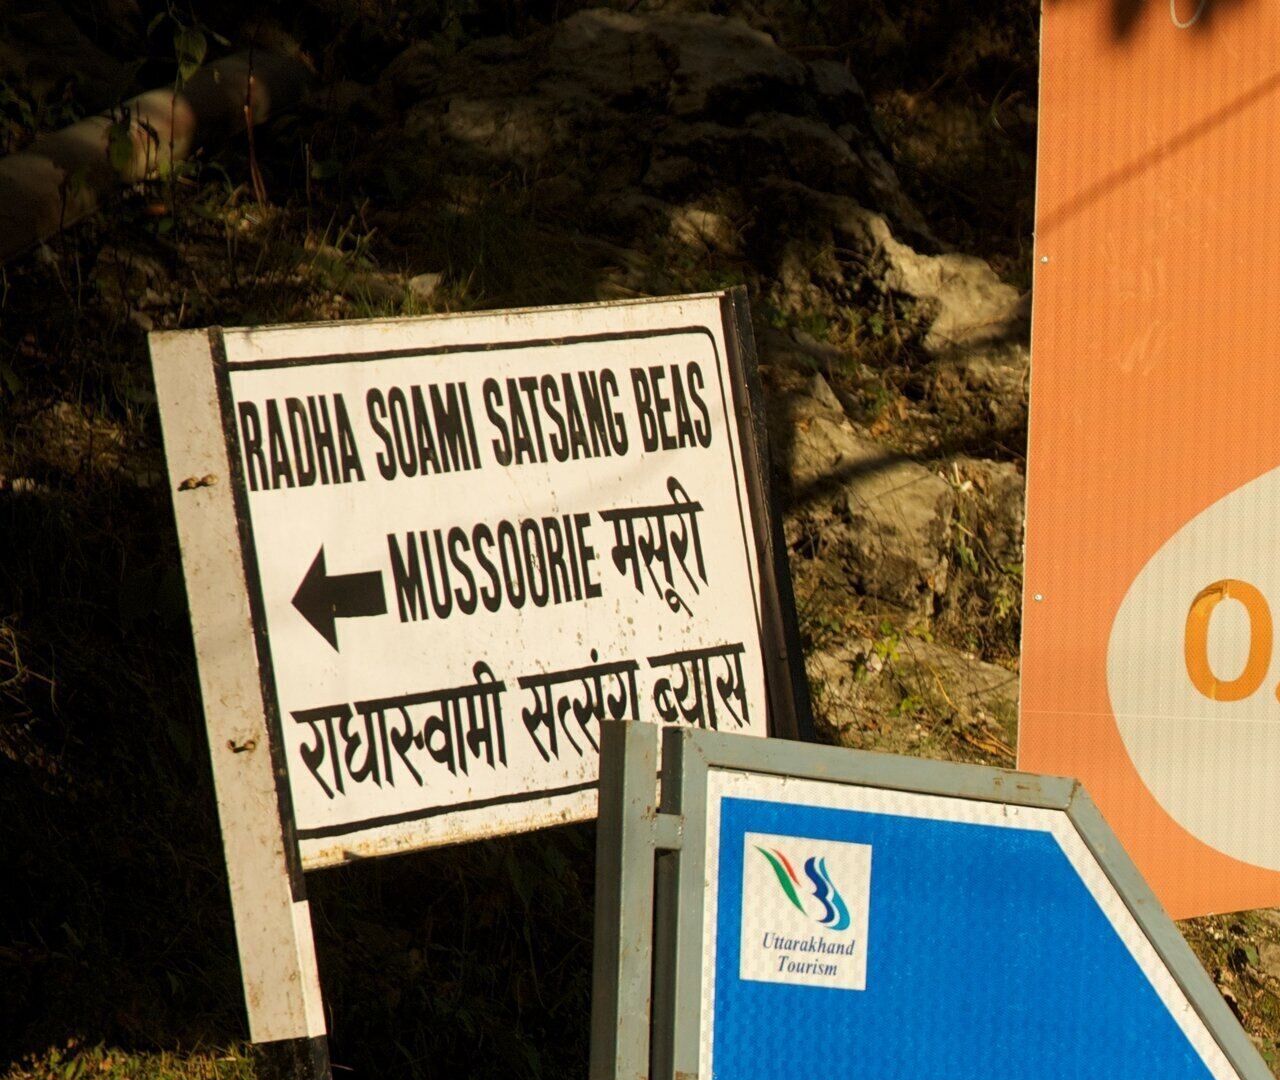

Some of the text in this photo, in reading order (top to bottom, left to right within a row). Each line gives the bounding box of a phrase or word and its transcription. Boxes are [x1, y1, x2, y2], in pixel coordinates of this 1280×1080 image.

[238, 361, 713, 491] RADHA SOAMI SATSANG BEAS
[387, 512, 602, 622] MUSSOORIE
[598, 476, 709, 617] मसूरी
[290, 660, 508, 799] राधास्वामी
[762, 932, 855, 955] Uttarakhand
[778, 955, 837, 976] Tourism
